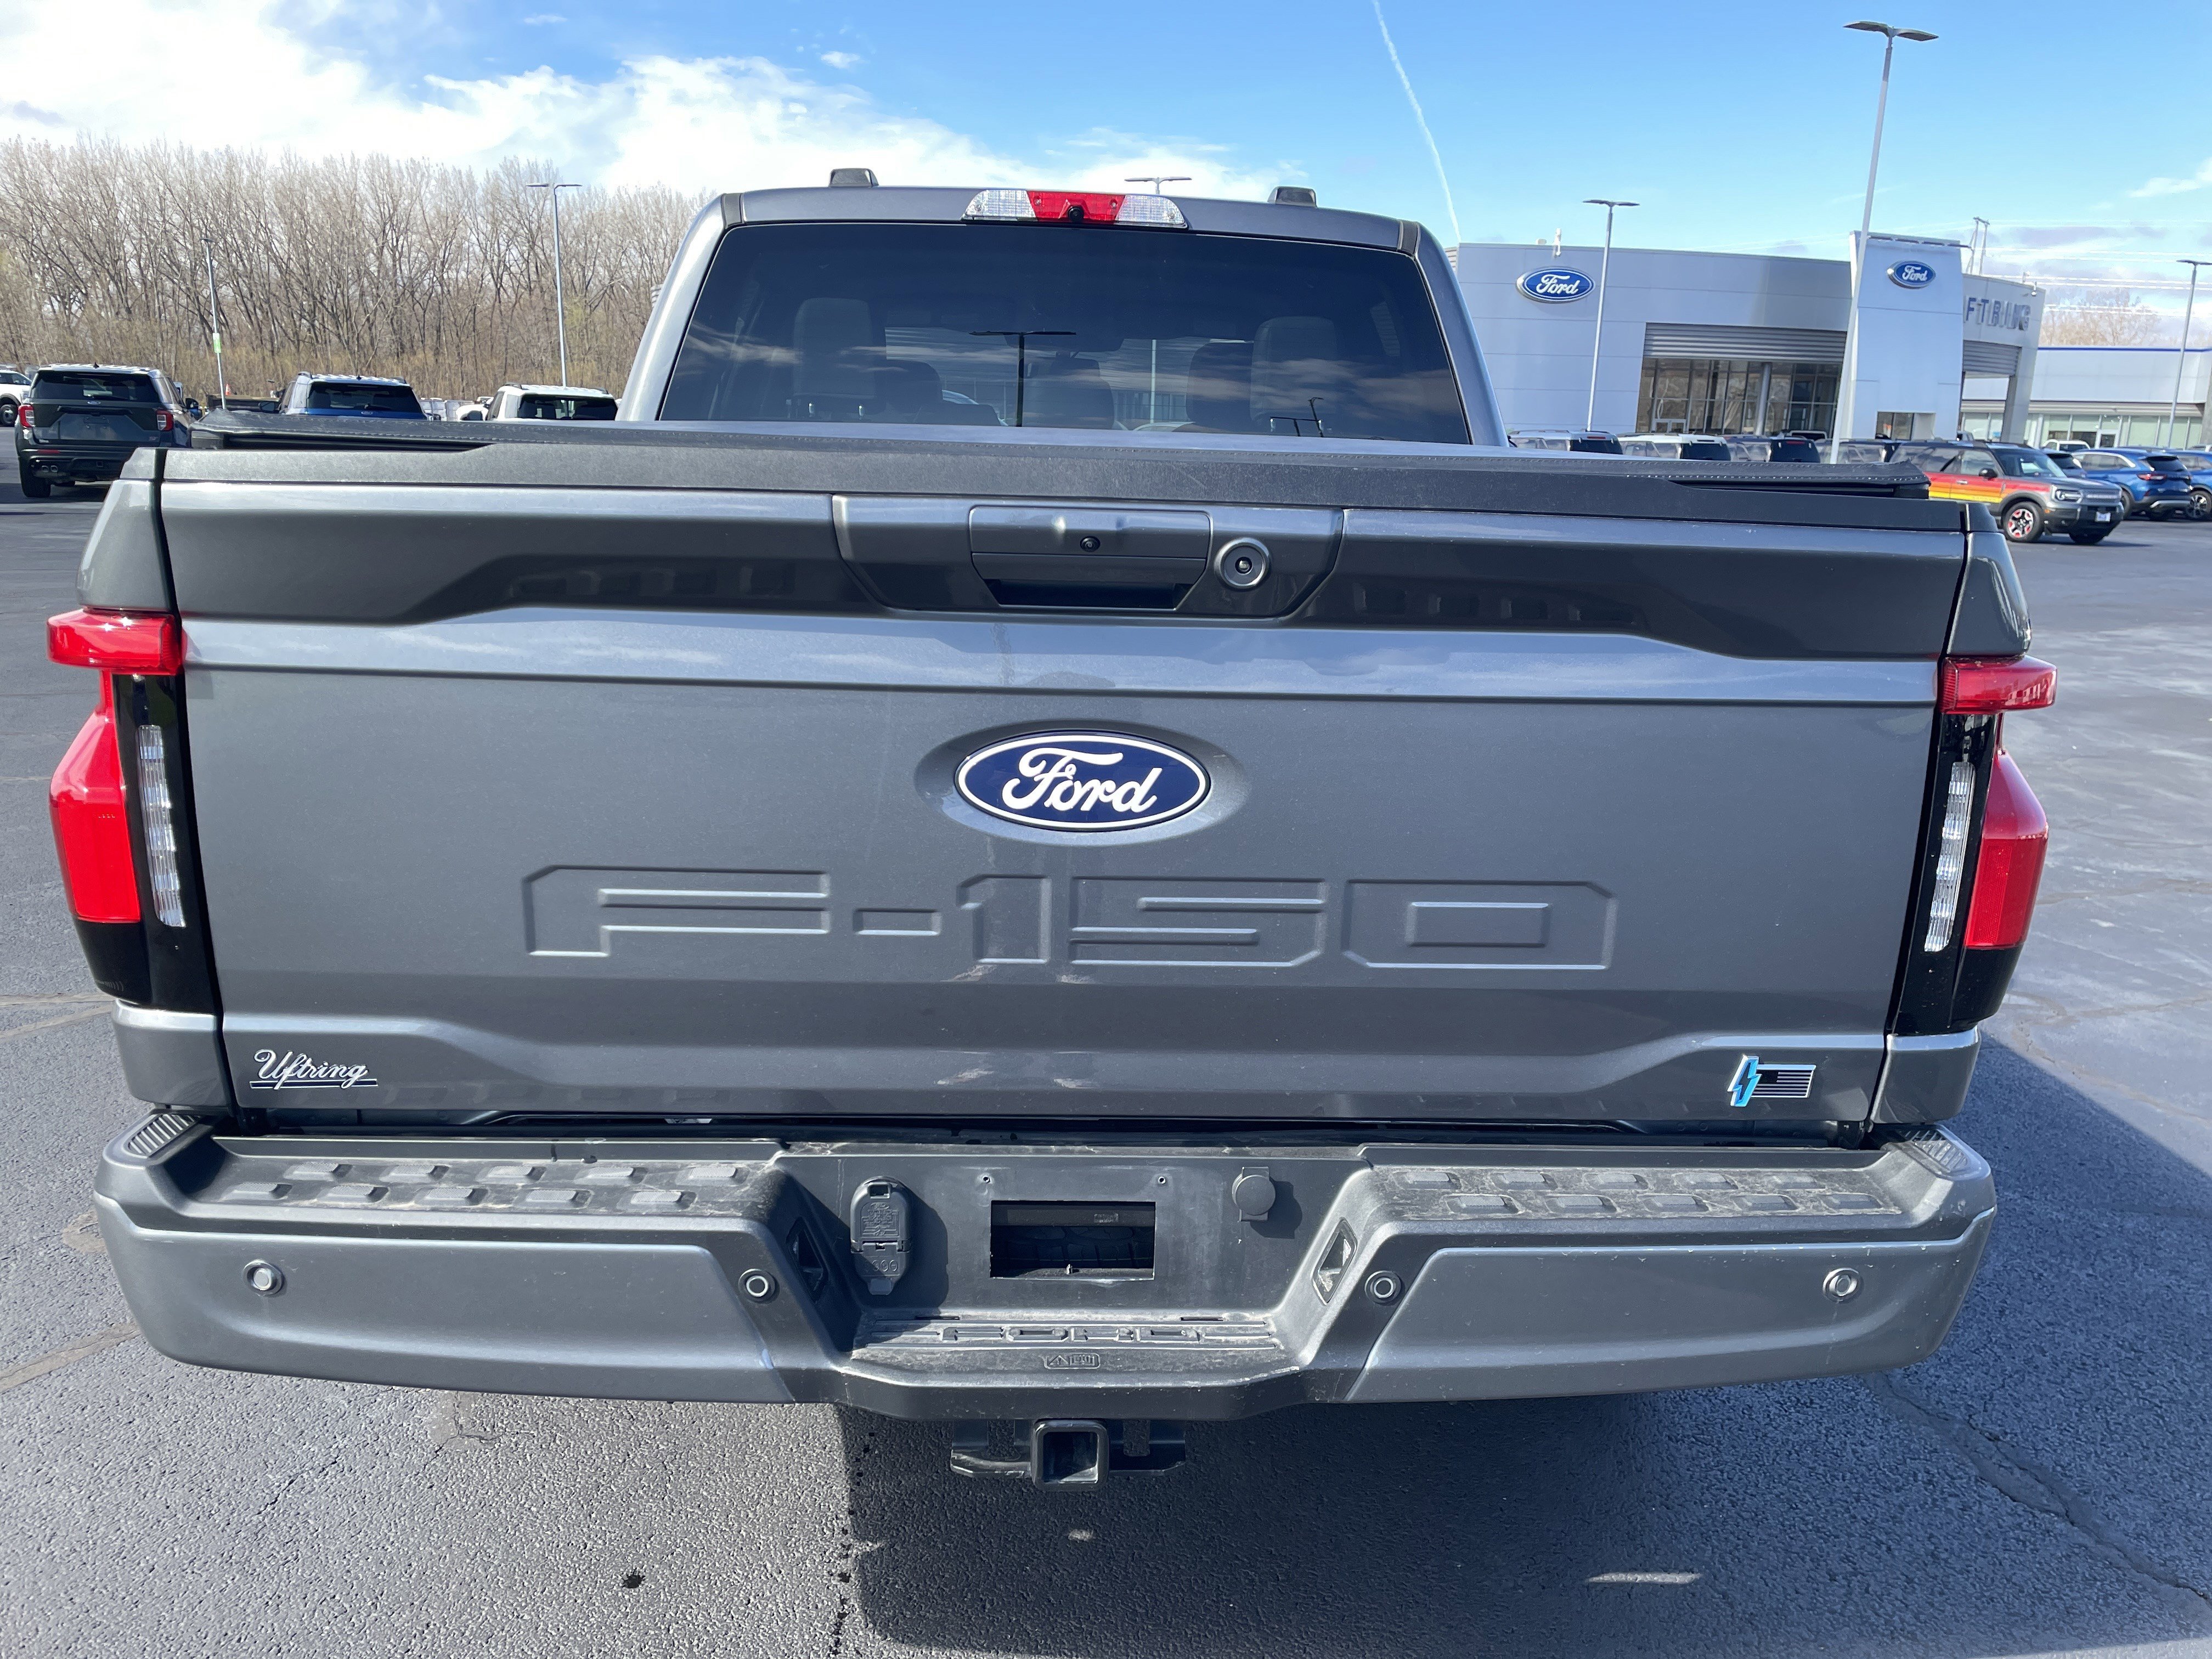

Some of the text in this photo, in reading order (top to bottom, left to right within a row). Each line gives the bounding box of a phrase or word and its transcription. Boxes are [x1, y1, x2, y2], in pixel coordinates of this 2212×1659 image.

[1536, 274, 1581, 294] Ford
[1902, 265, 1928, 281] Ford
[1963, 296, 2031, 330] FTRING
[1002, 747, 1163, 813] Ford
[522, 864, 1618, 973] F-150
[253, 1049, 369, 1090] Uftring
